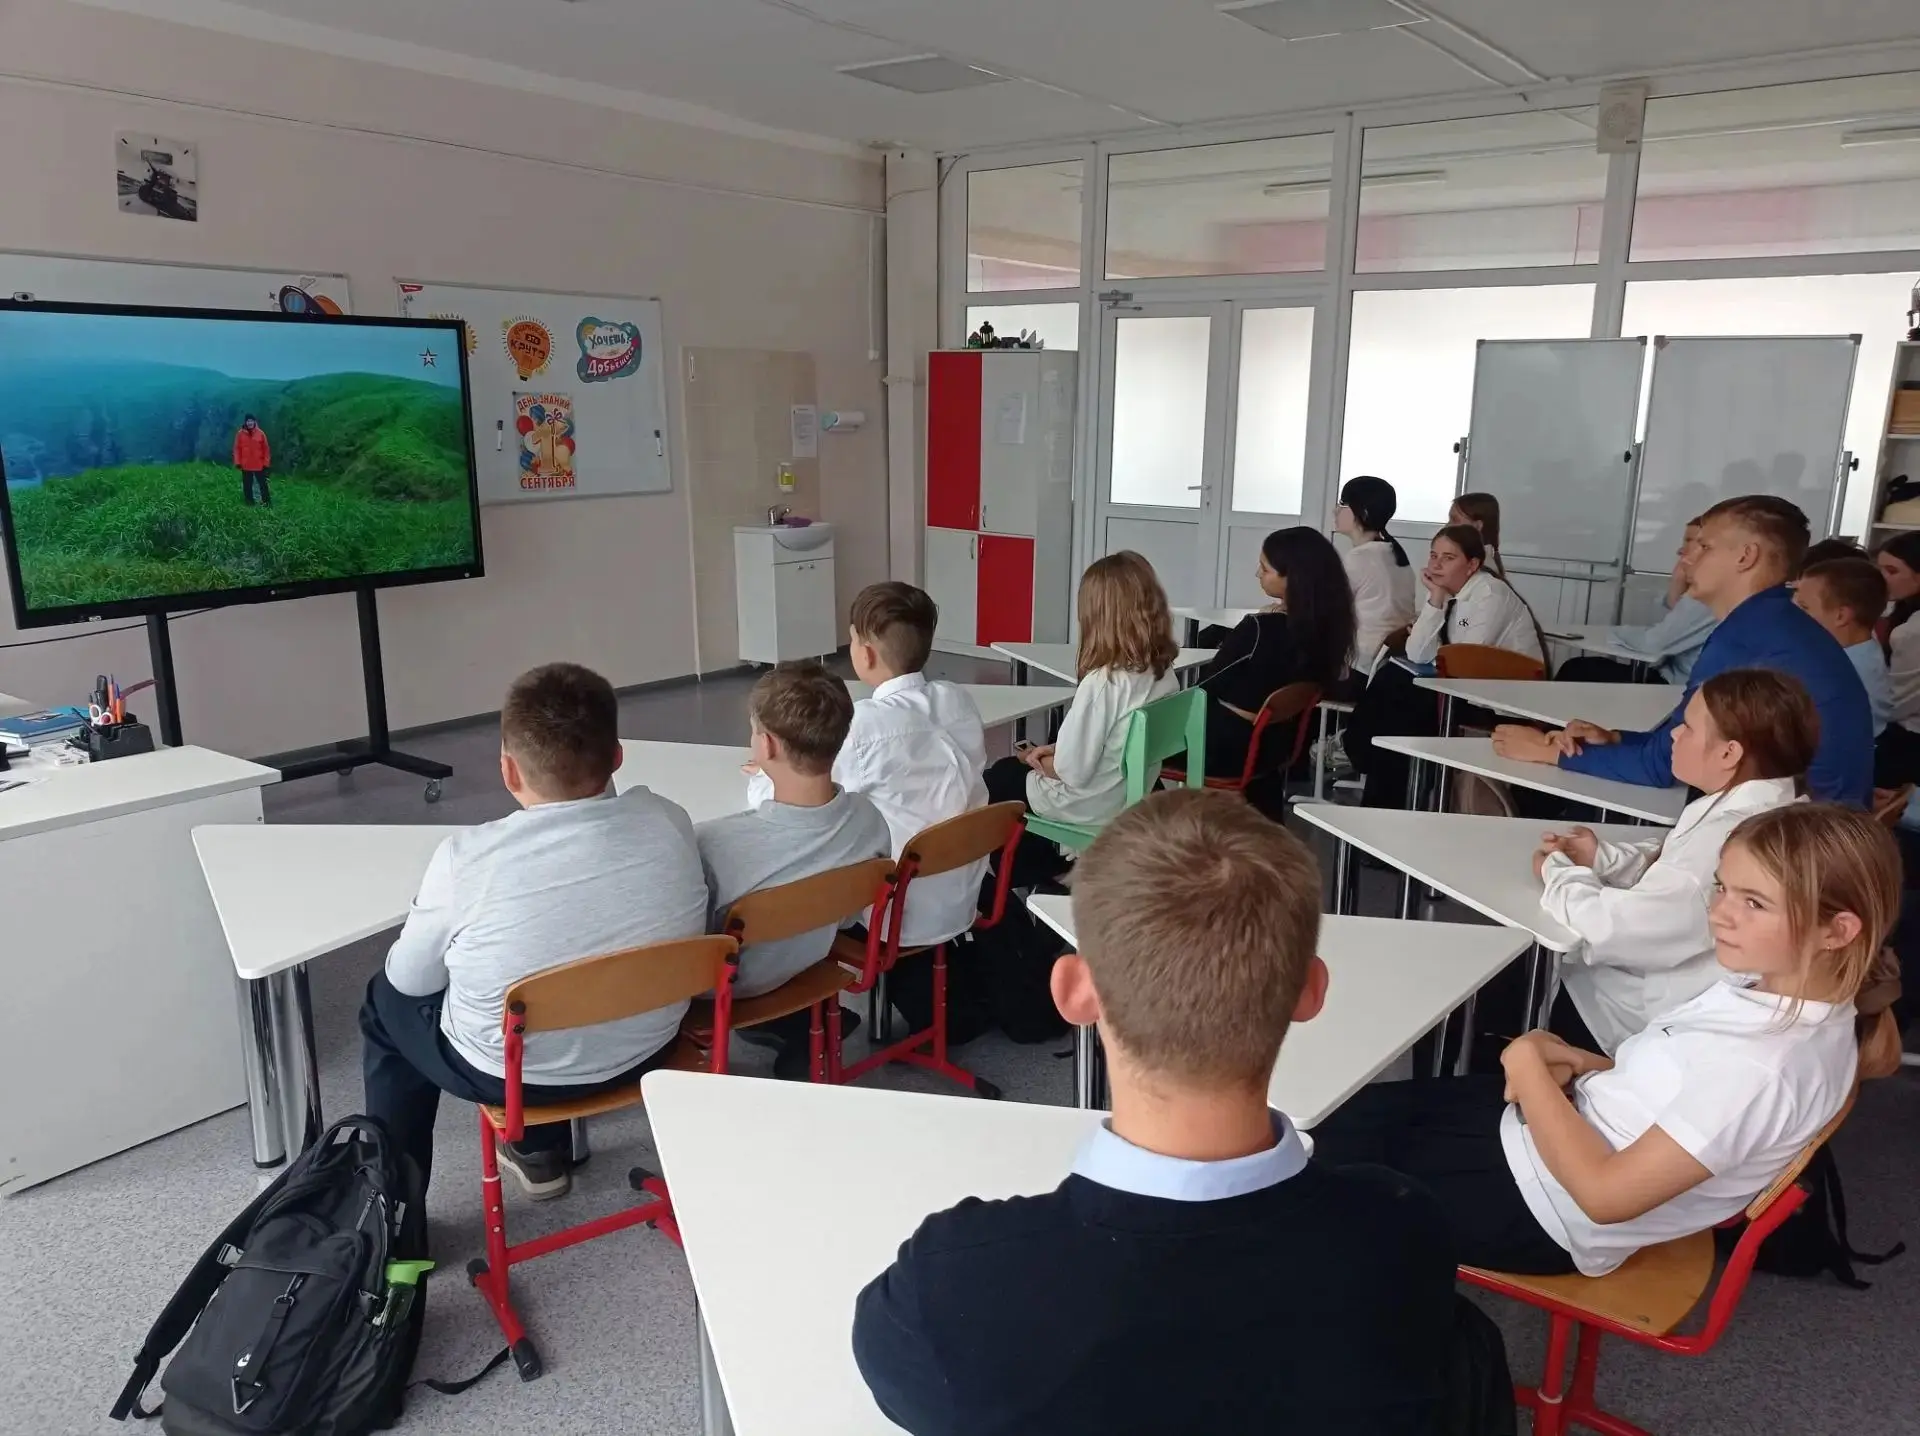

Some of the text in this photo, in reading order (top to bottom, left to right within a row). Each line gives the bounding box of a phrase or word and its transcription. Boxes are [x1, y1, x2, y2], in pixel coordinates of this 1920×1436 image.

[517, 394, 570, 412] ДЕНЬ ЗНАНИЙ
[520, 476, 575, 489] СЕНТЯБРЯ
